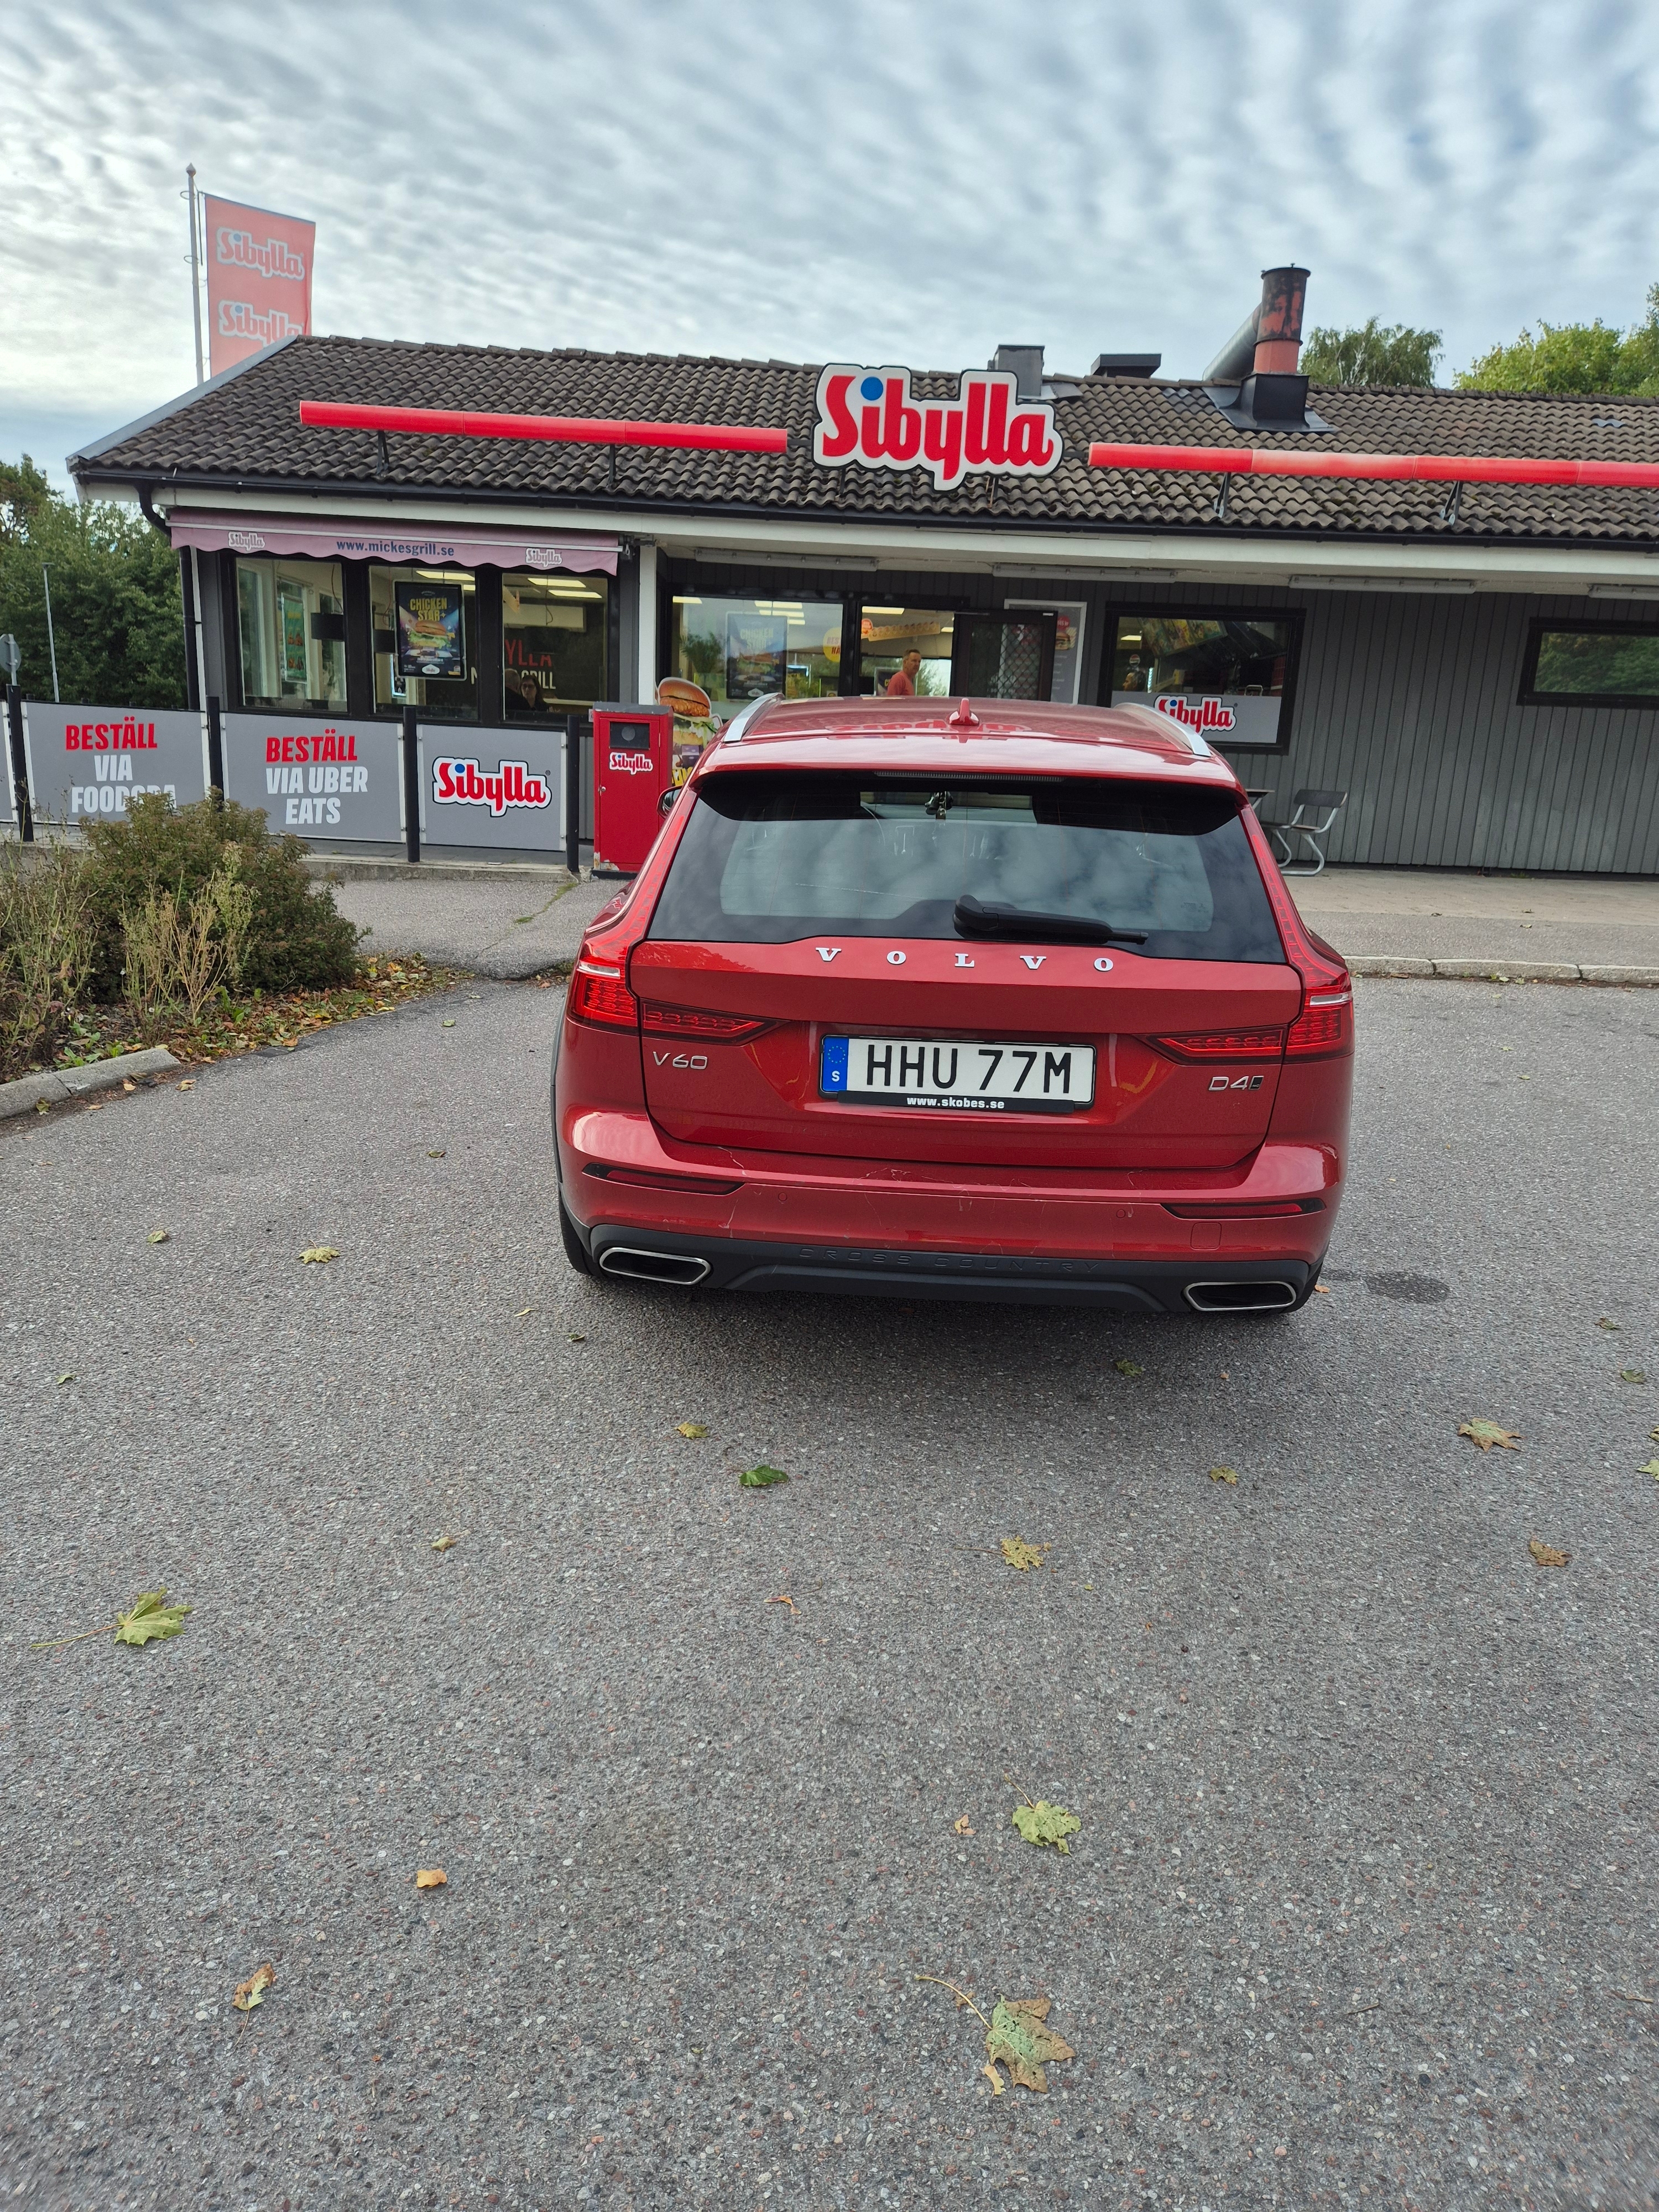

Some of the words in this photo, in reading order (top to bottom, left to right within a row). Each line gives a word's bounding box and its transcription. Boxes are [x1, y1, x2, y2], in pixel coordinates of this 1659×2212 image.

[221, 231, 302, 277] Sibylla
[822, 375, 1053, 481] Sibylla
[229, 532, 264, 550] Sibylla
[337, 541, 454, 556] www.mickesgrill.se
[527, 548, 561, 566] Sibylla
[410, 598, 447, 611] CHICKEN
[418, 609, 440, 621] STAR
[66, 716, 158, 750] BESTÄLL
[266, 729, 358, 763] BESTÄLL
[94, 754, 133, 781] VIA
[611, 754, 652, 774] Sibylla
[265, 768, 304, 794] VIA
[307, 766, 368, 794] UBER
[439, 762, 547, 812] Sibylla
[285, 798, 341, 825] EATS
[816, 947, 1114, 972] VOLVO
[653, 1051, 708, 1070] V60
[867, 1045, 958, 1089] HHU
[978, 1049, 1072, 1094] 77M
[832, 1071, 840, 1082] S
[1208, 1076, 1249, 1092] D4
[907, 1096, 1005, 1109] www.skobes.se
[799, 1248, 912, 1265] CROSS
[934, 1257, 1099, 1272] COUNTRY
